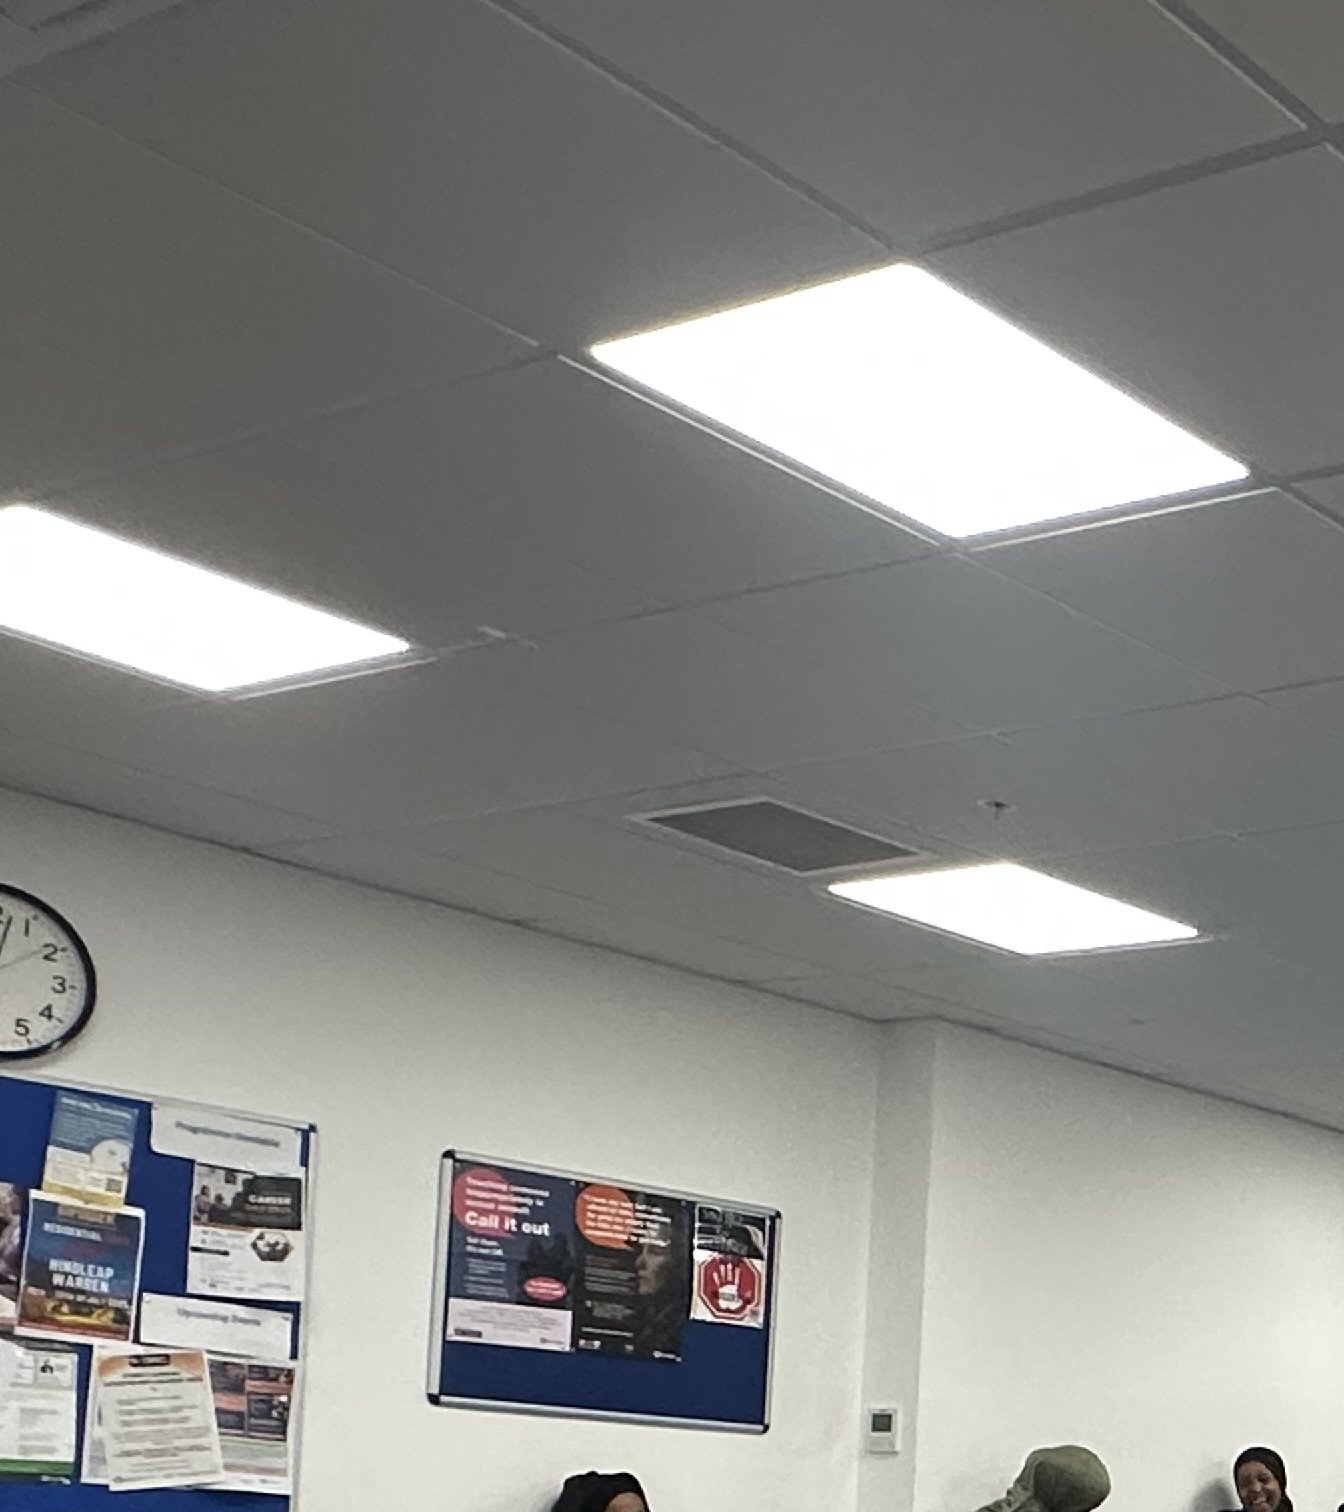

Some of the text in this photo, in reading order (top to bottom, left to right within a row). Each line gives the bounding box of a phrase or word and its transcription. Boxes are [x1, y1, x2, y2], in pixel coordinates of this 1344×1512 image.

[42, 943, 58, 962] 2
[51, 975, 66, 993] 3
[38, 1003, 54, 1021] 4
[14, 1018, 30, 1037] 5
[465, 1211, 550, 1237] Call it out
[52, 1272, 110, 1293] WARREN
